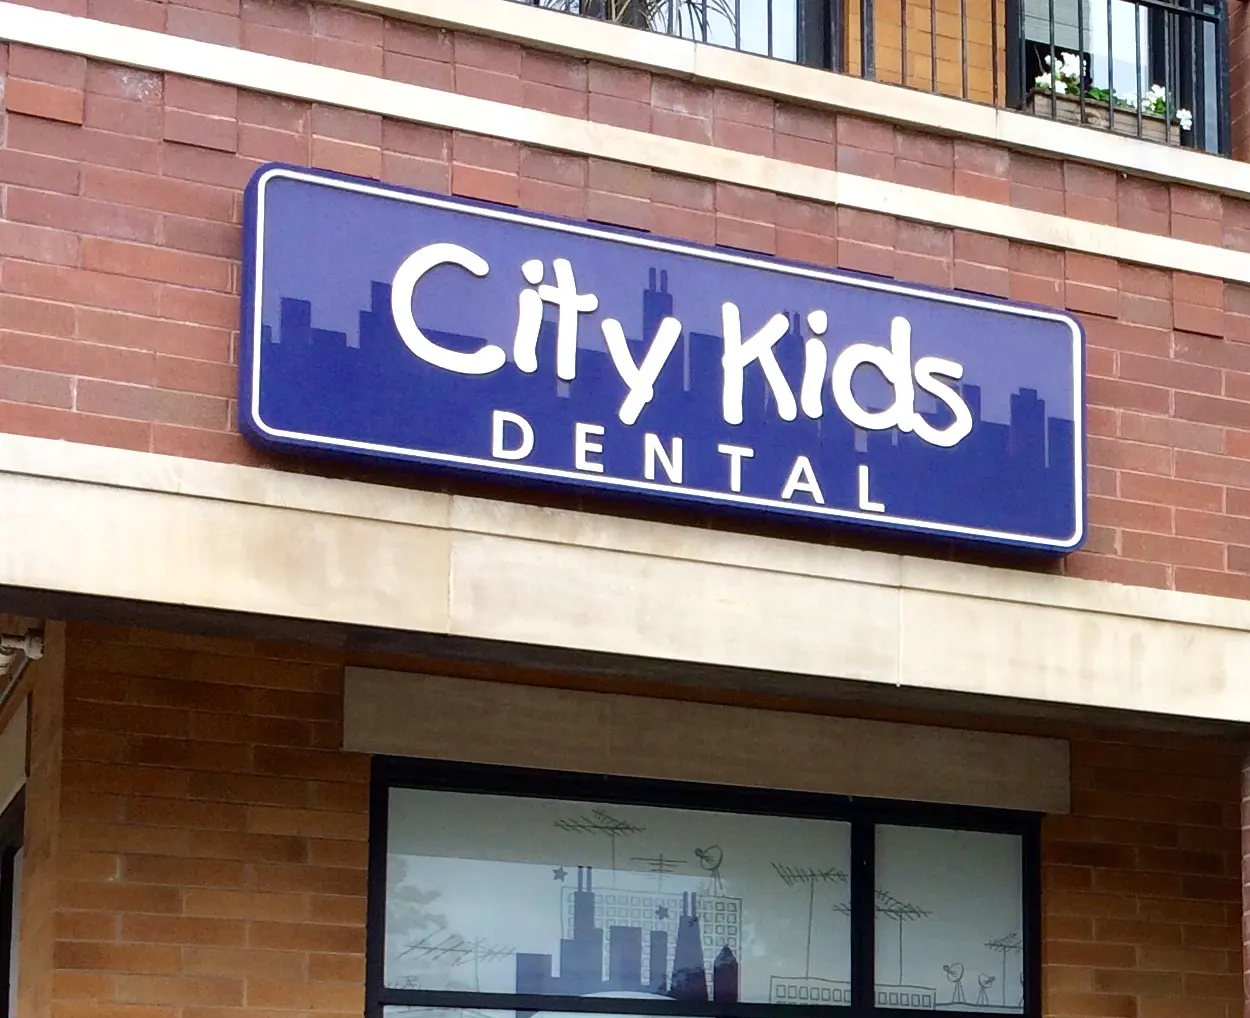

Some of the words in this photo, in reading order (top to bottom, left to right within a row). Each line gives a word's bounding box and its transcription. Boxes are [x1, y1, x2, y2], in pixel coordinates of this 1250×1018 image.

[391, 243, 683, 426] City
[722, 301, 974, 448] Kids
[491, 409, 886, 512] DENTAL
